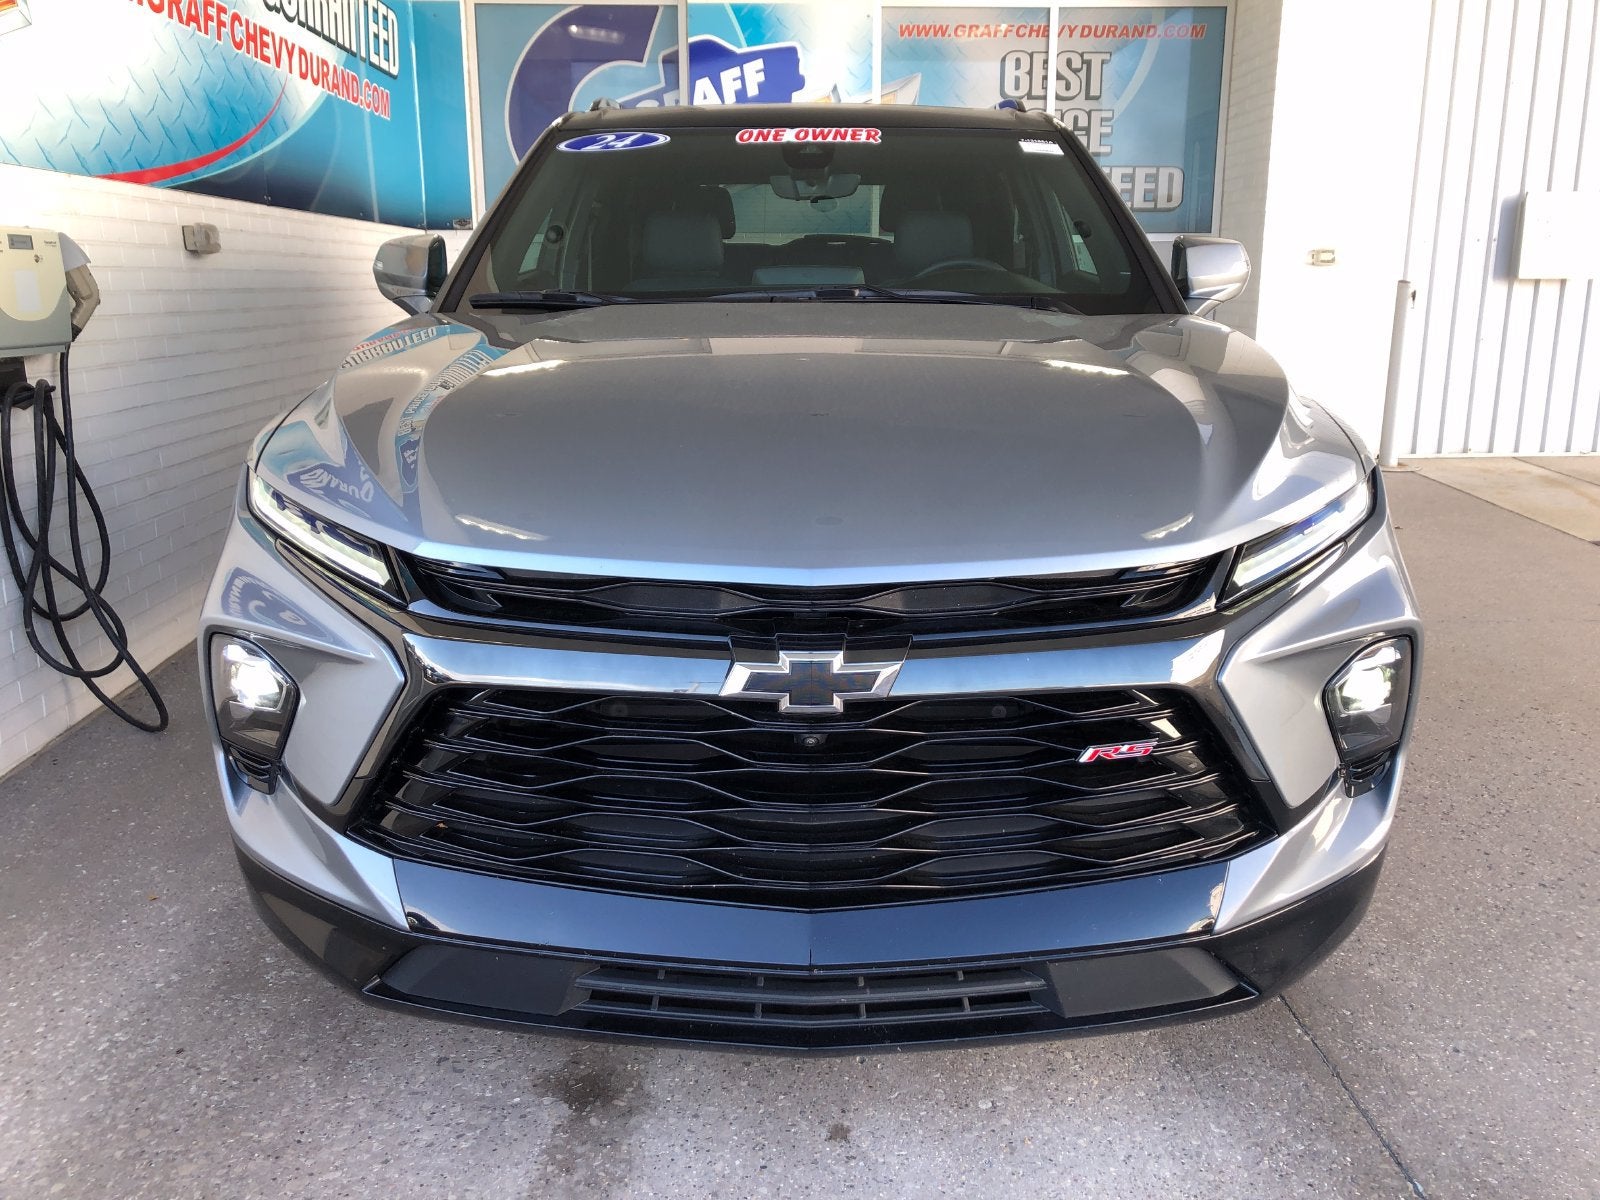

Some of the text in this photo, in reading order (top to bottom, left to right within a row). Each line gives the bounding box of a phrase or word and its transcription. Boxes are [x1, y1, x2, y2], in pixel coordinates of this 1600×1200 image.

[1000, 49, 1112, 101] BEST
[581, 133, 643, 150] 24
[738, 128, 881, 143] ONE OWNER
[1079, 742, 1157, 762] RS
